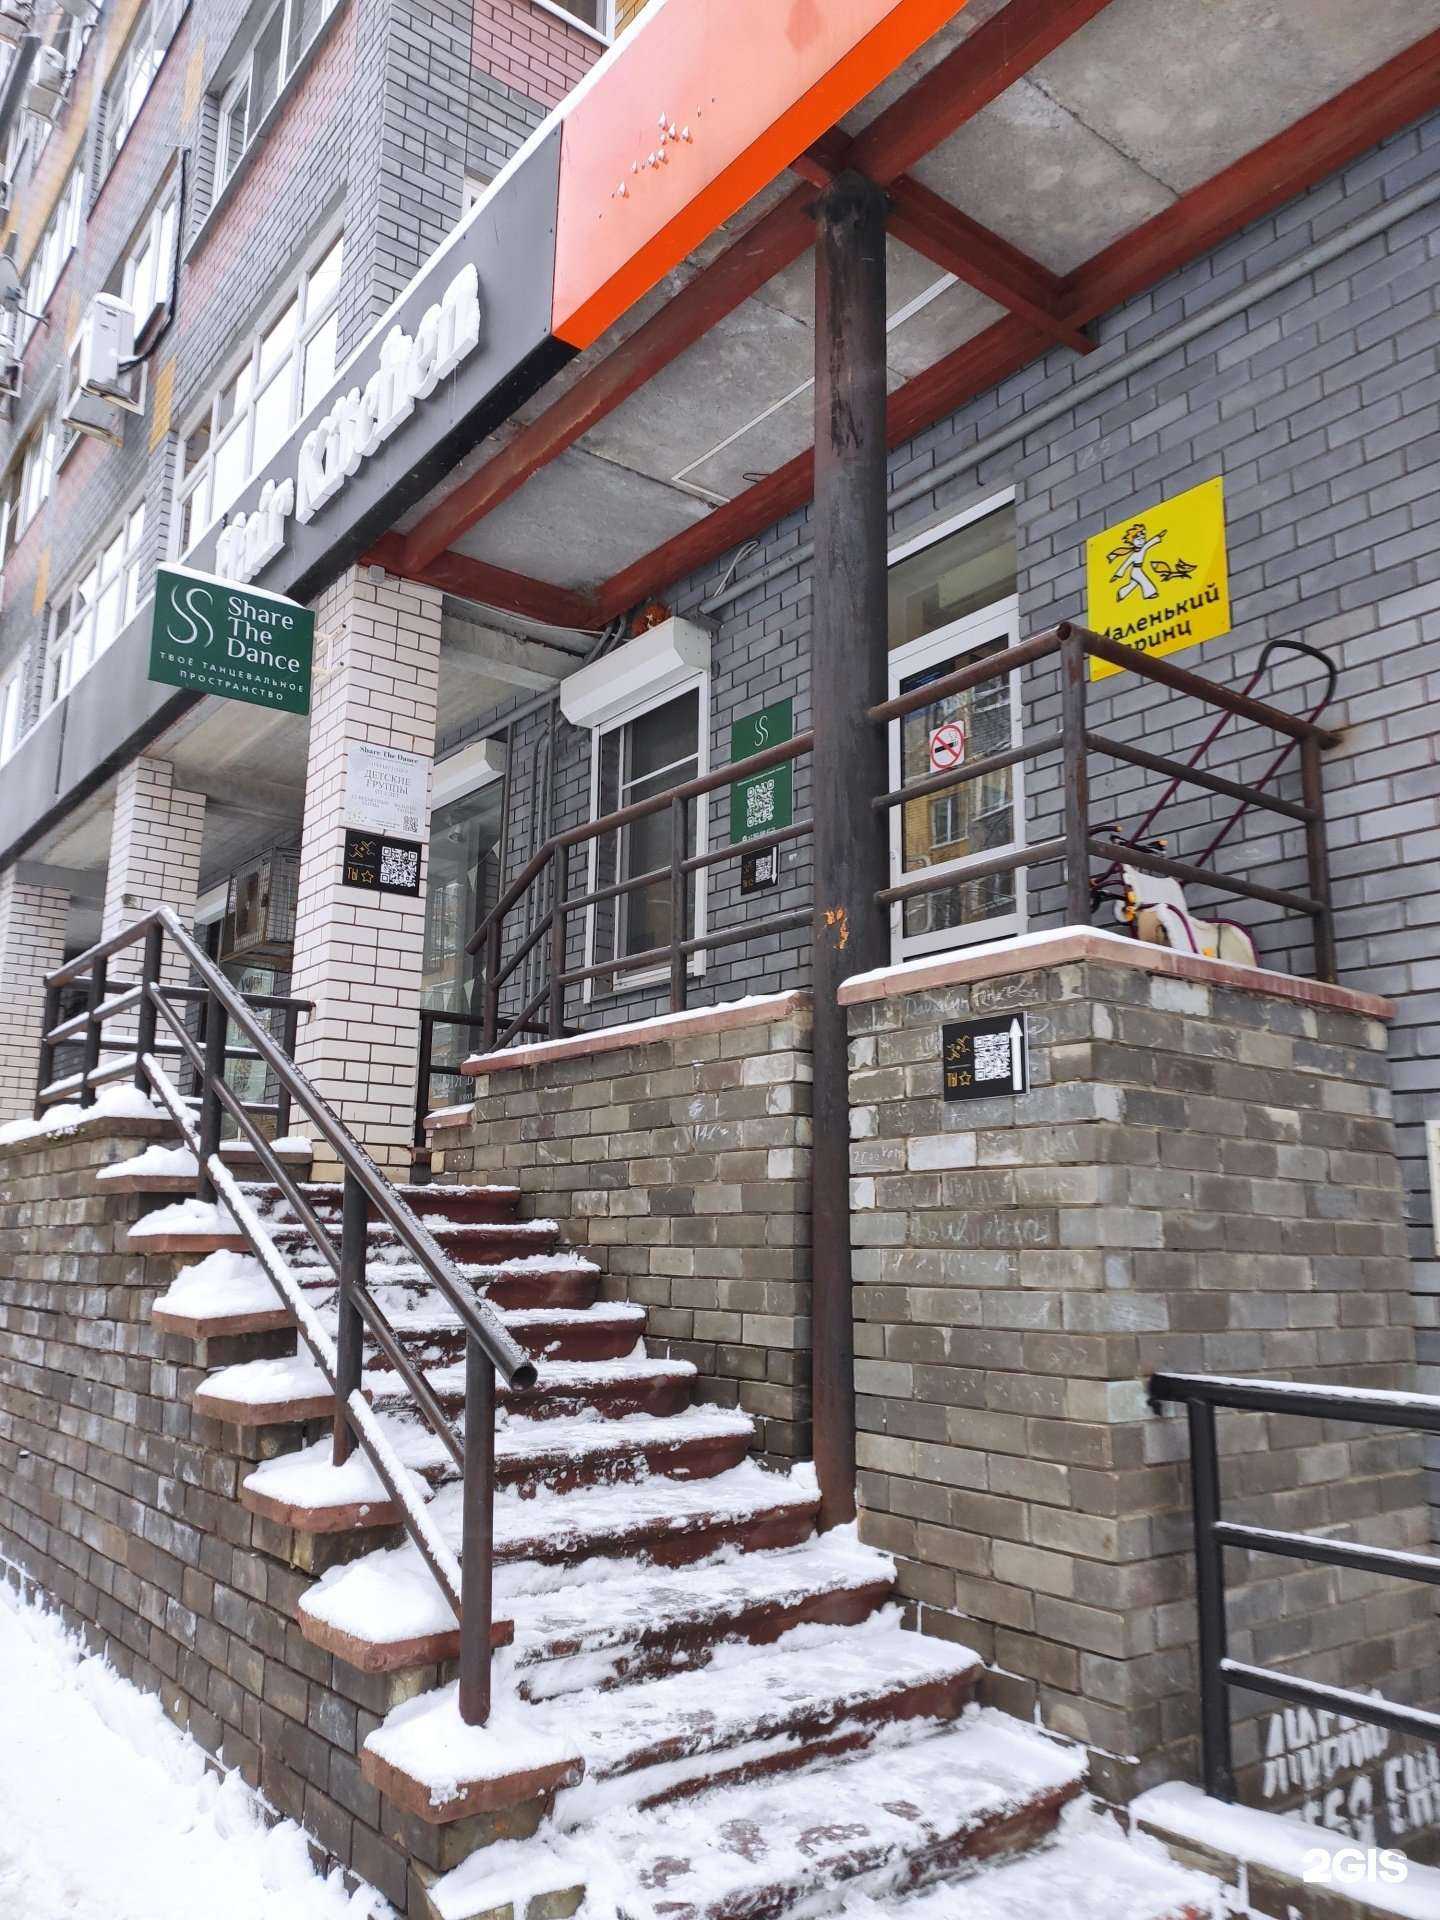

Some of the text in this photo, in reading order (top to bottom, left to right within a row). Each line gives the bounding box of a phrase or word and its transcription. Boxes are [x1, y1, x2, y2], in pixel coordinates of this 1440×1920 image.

[227, 596, 294, 630] Share
[227, 616, 273, 645] The
[1128, 620, 1191, 651] ринц
[226, 637, 300, 673] Dance
[179, 670, 283, 701] ПРОСТРАНСТВО
[202, 661, 304, 693] ТАНЦЕВАЛЬНОЕ
[364, 769, 410, 785] ДЕТСКИЕ
[365, 778, 409, 795] ГРУППЫ
